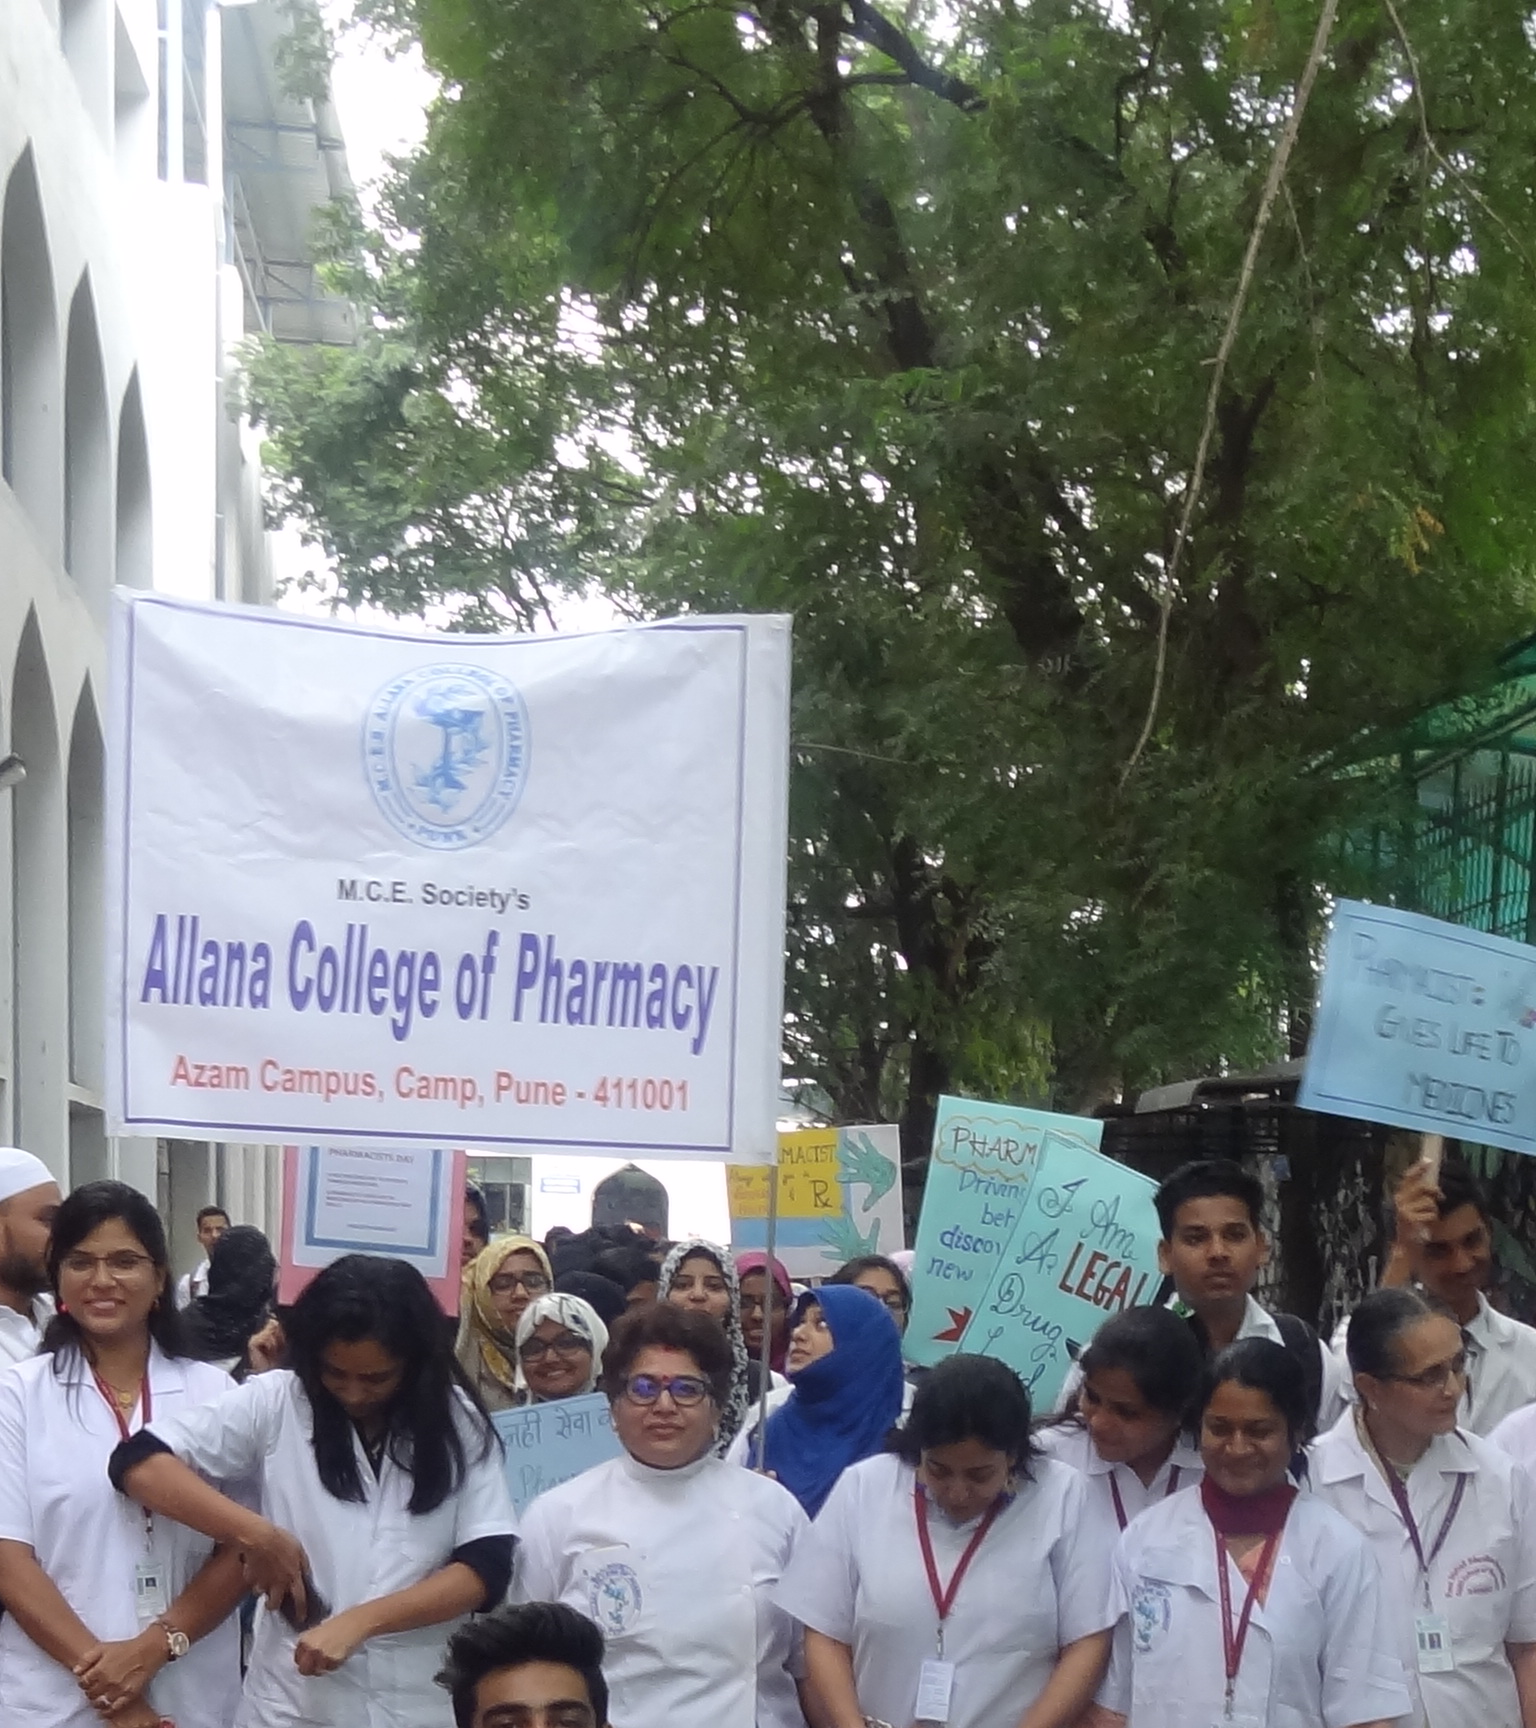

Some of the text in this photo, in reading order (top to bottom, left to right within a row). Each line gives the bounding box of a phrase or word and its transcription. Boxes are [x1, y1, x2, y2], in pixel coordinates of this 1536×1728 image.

[337, 878, 530, 914] M.C.E. Society's
[140, 913, 720, 1056] Allana College of Pharmacy
[170, 1054, 250, 1092] Azam
[262, 1059, 384, 1103] Campus,
[395, 1066, 484, 1108] Camp,
[494, 1071, 566, 1106] Pune
[594, 1076, 690, 1112] 411001
[1079, 1195, 1140, 1260] Am
[926, 1256, 974, 1281] new
[1058, 1241, 1150, 1312] LEGAL
[989, 1272, 1062, 1362] Drug
